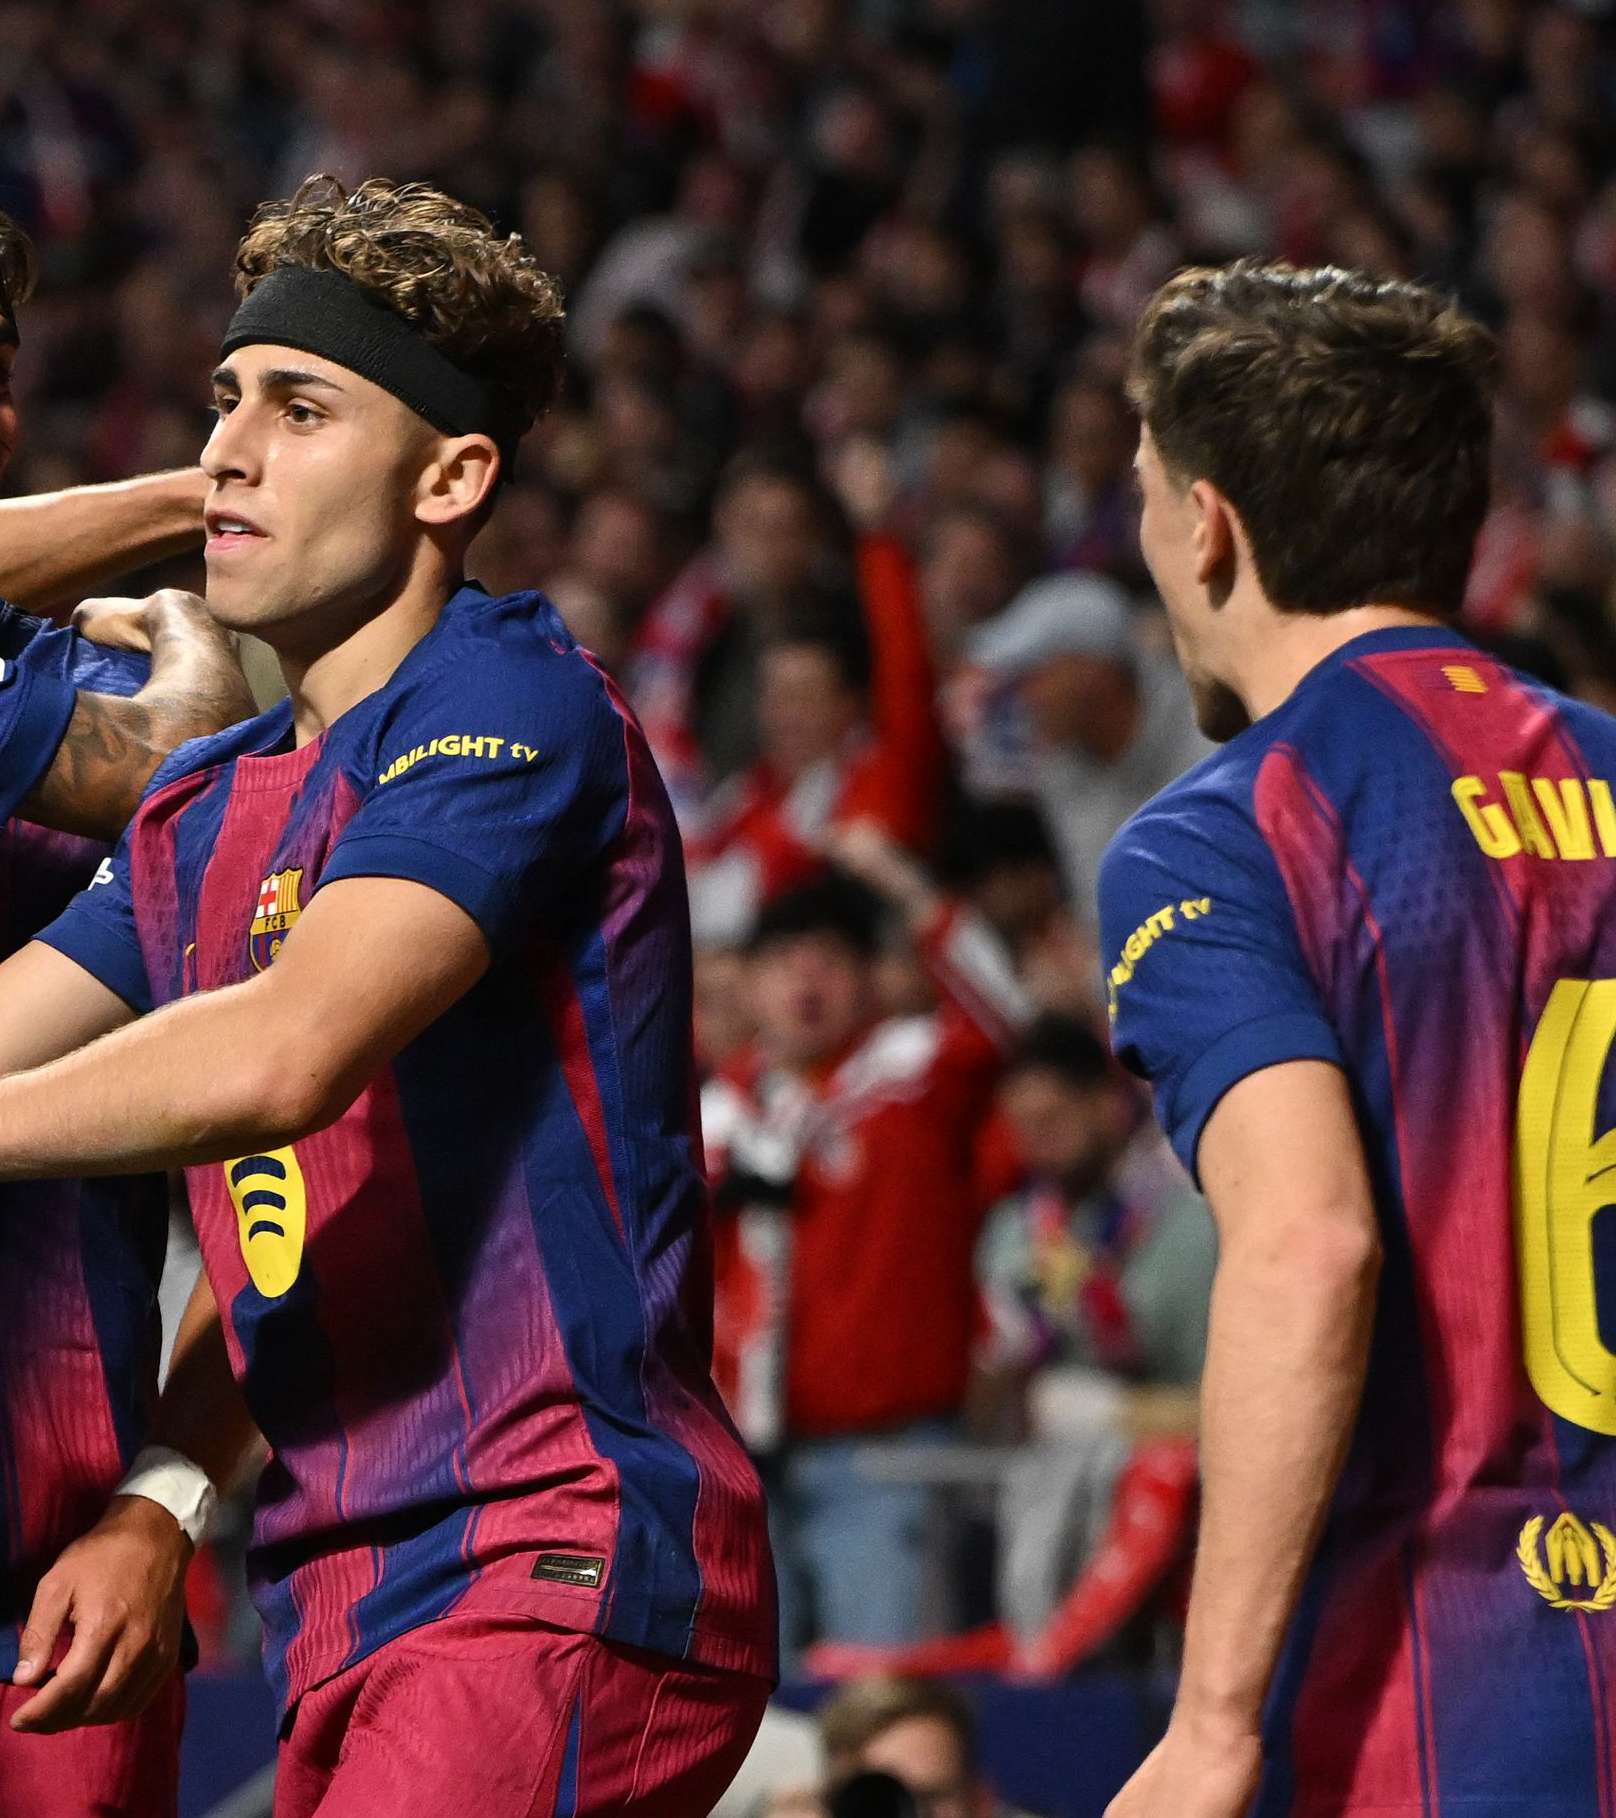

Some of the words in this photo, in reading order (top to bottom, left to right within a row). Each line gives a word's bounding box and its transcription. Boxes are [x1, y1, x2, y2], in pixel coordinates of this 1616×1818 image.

[510, 743, 539, 763] tv
[1451, 769, 1616, 860] GAVI
[265, 914, 287, 931] FCB
